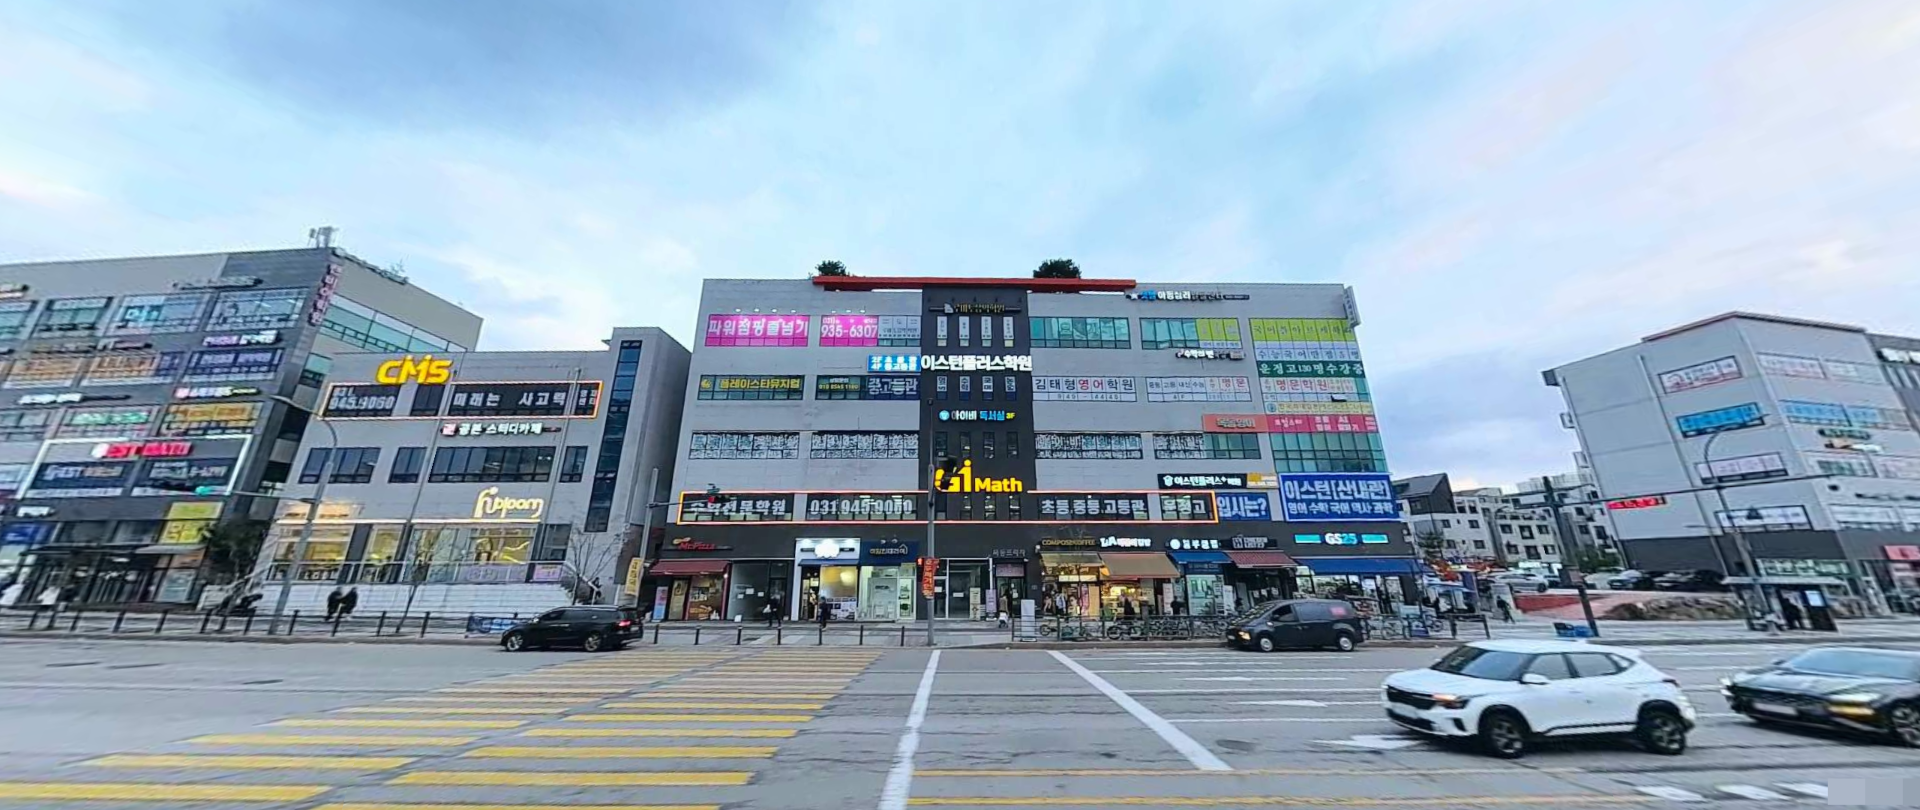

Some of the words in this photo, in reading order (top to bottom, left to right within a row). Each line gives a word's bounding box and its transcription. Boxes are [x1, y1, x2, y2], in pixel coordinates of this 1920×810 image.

[708, 318, 809, 336] 파워점핑줄넘기
[821, 324, 878, 338] 935-6307
[376, 355, 453, 385] CMS
[921, 355, 1032, 371] 이스턴플러스학원
[720, 379, 800, 389] 플레이스타뮤지컬
[1035, 378, 1134, 391] 김태형영어학원
[453, 392, 501, 407] 미래는
[518, 391, 566, 406] 사고력
[980, 410, 1005, 421] 독서실
[485, 423, 543, 435] 스터디카페
[974, 477, 1023, 493] Math
[1217, 496, 1267, 517] 입시는?
[1287, 502, 1308, 514] 영어
[1309, 502, 1329, 514] 수학
[1330, 502, 1350, 514] 국어
[1352, 502, 1372, 514] 역사
[1373, 502, 1393, 514] 과학
[1325, 533, 1357, 545] GS25
